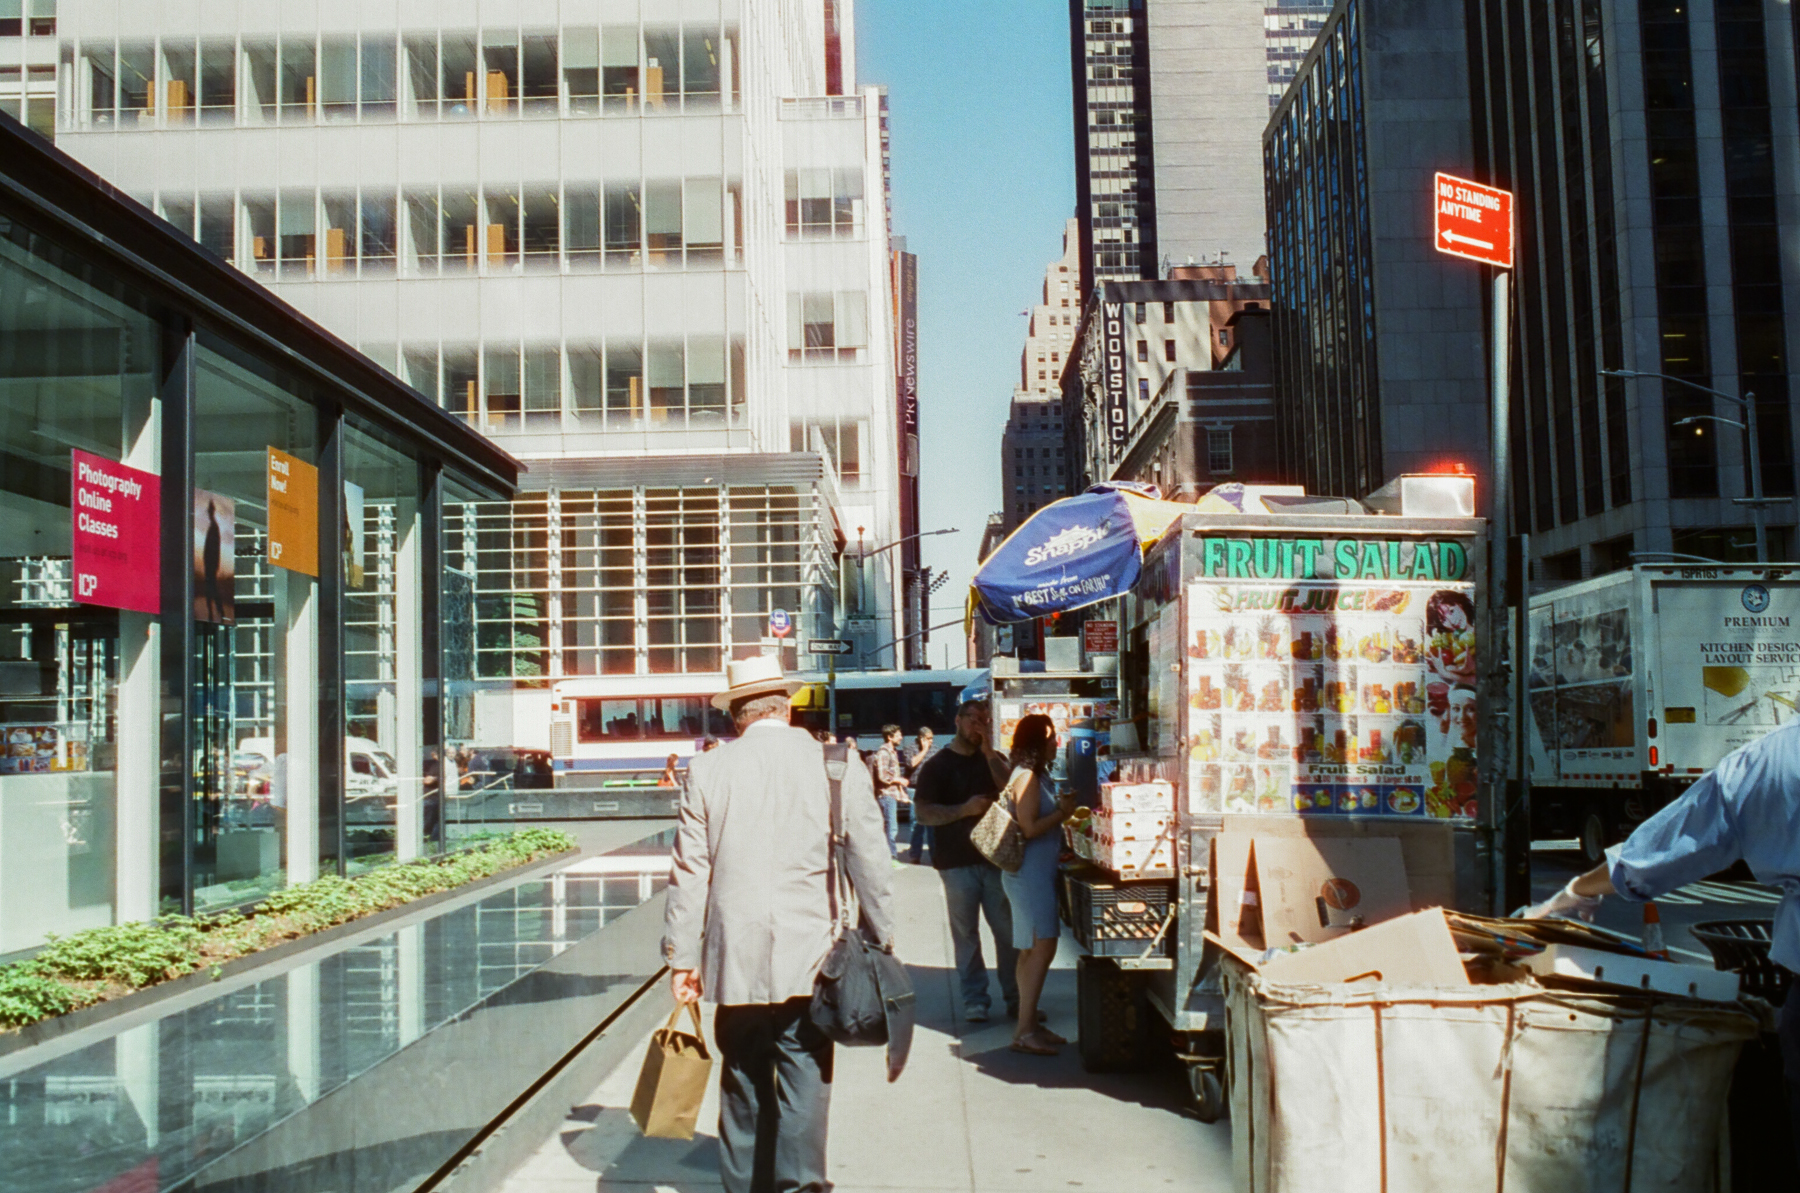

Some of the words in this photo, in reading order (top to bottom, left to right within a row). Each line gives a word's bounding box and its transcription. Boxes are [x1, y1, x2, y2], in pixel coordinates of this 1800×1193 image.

[1440, 182, 1453, 198] NO
[1456, 186, 1500, 211] STANDING
[1440, 199, 1482, 223] ANYTIME
[270, 454, 290, 477] Enroll
[78, 461, 142, 501] Photography
[270, 475, 288, 494] Now!
[78, 487, 113, 513] Online
[78, 512, 119, 539] Classes
[270, 541, 282, 560] ICP
[1203, 536, 1323, 580] FRUIT
[1334, 538, 1468, 582] SALAD
[1680, 568, 1718, 579] 15PR163
[78, 573, 98, 597] ICP
[1024, 588, 1049, 605] BEST
[1233, 589, 1300, 611] FRUIT
[1300, 589, 1368, 612] JUICE
[1723, 616, 1791, 627] PREMIUM
[1700, 642, 1755, 653] KITCHEN
[1757, 642, 1800, 653] DESIGN
[1705, 653, 1752, 664] LAYOUT
[1755, 653, 1800, 664] SERVIC
[1081, 740, 1091, 754] P
[1308, 764, 1349, 775] Fruit
[1356, 764, 1406, 775] Salad
